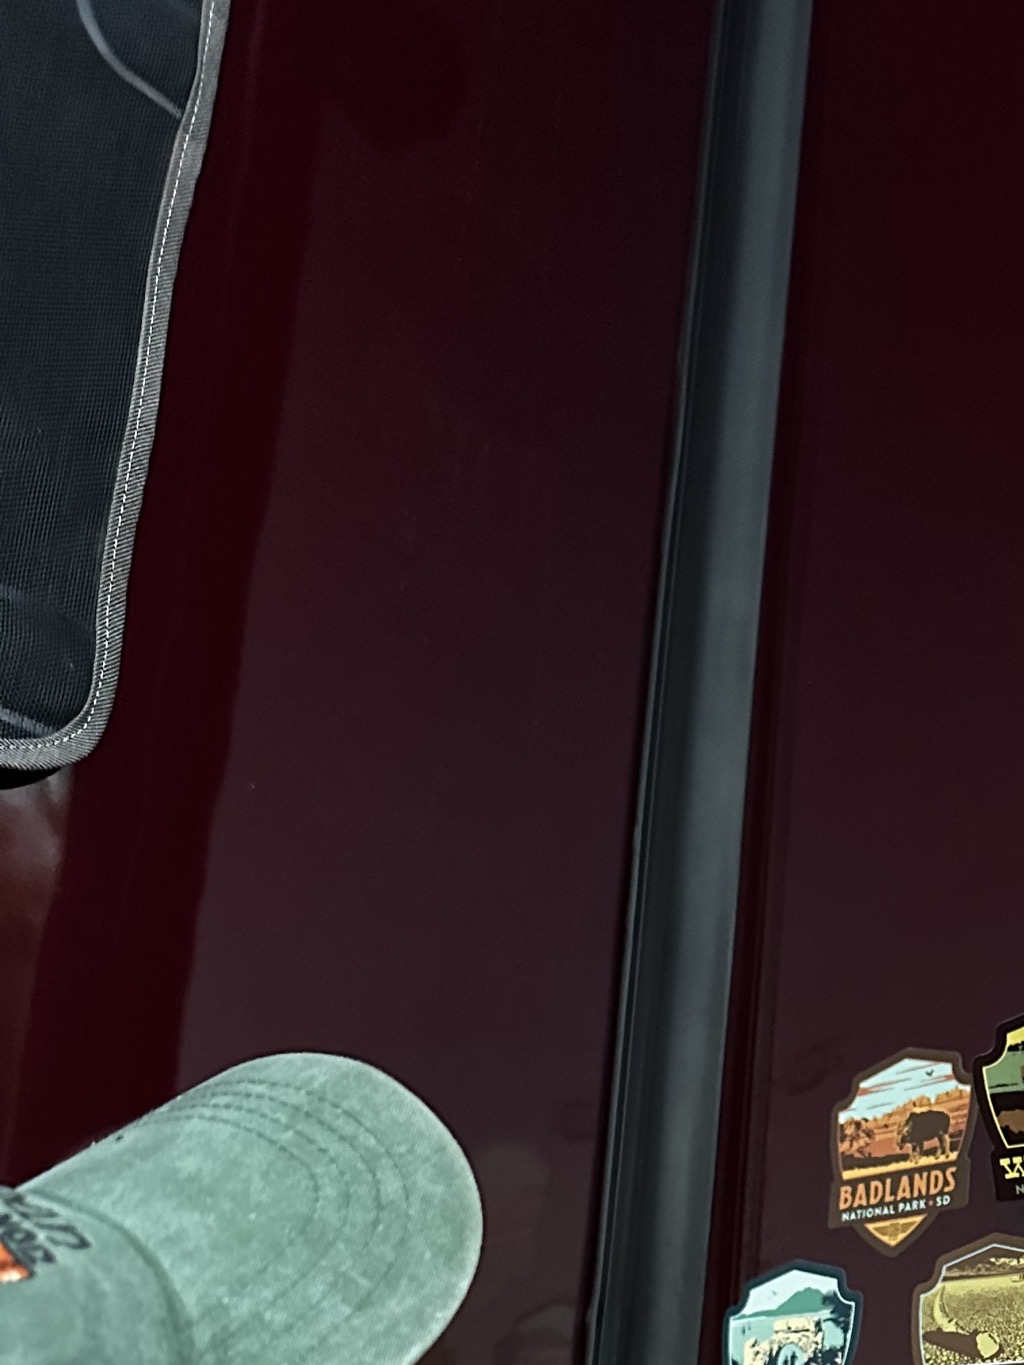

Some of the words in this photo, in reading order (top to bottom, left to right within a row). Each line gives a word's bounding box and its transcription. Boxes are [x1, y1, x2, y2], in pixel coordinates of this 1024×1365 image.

[839, 1167, 957, 1210] BADLANDS
[841, 1205, 895, 1221] NATIONAL
[898, 1199, 926, 1214] PARK
[935, 1195, 951, 1207] SD
